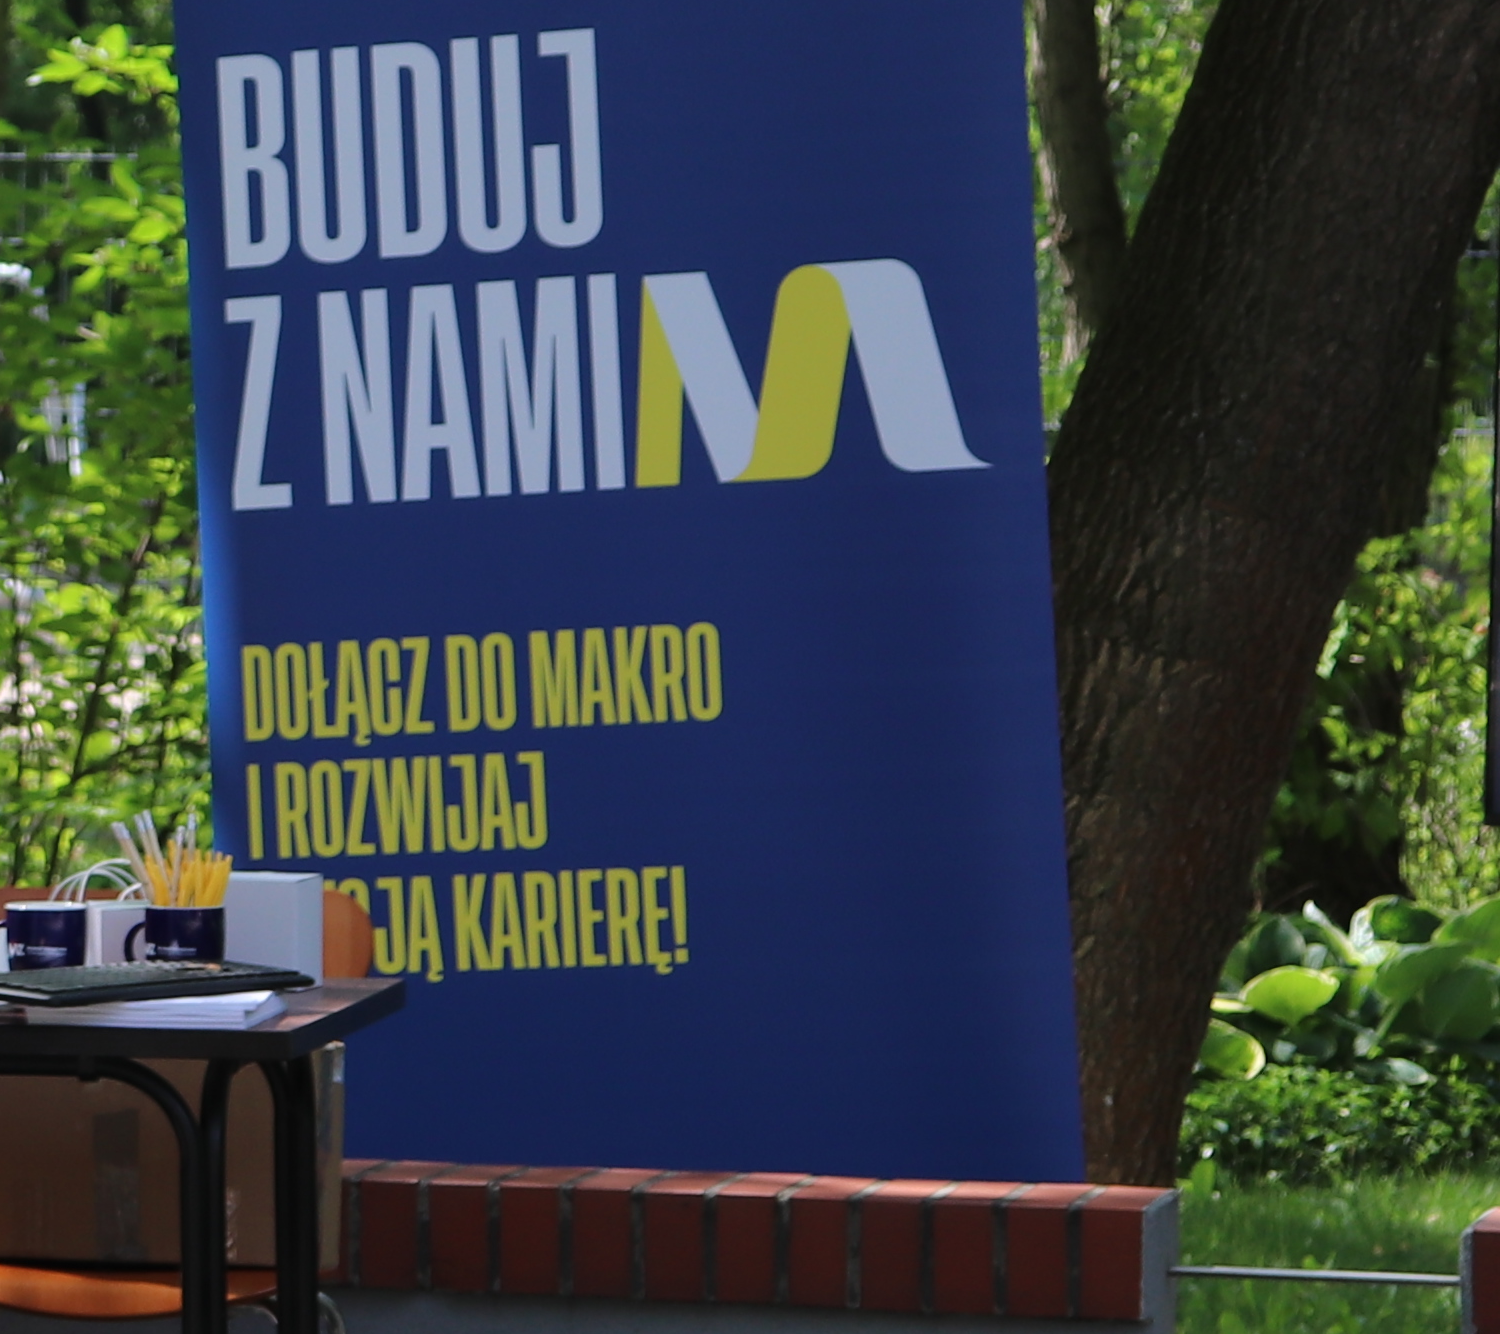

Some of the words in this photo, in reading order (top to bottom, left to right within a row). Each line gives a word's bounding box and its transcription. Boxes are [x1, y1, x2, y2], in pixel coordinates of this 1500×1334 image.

[215, 27, 603, 269] BUDUJ
[224, 294, 293, 511] Z
[317, 273, 626, 506] NAMI
[241, 636, 434, 746] DOŁĄCZ
[445, 632, 517, 732] DO
[528, 621, 723, 728] MAKRO
[246, 763, 264, 860] I
[275, 751, 548, 859] ROZWIJAJ
[453, 866, 689, 975] KARIERĘ!
